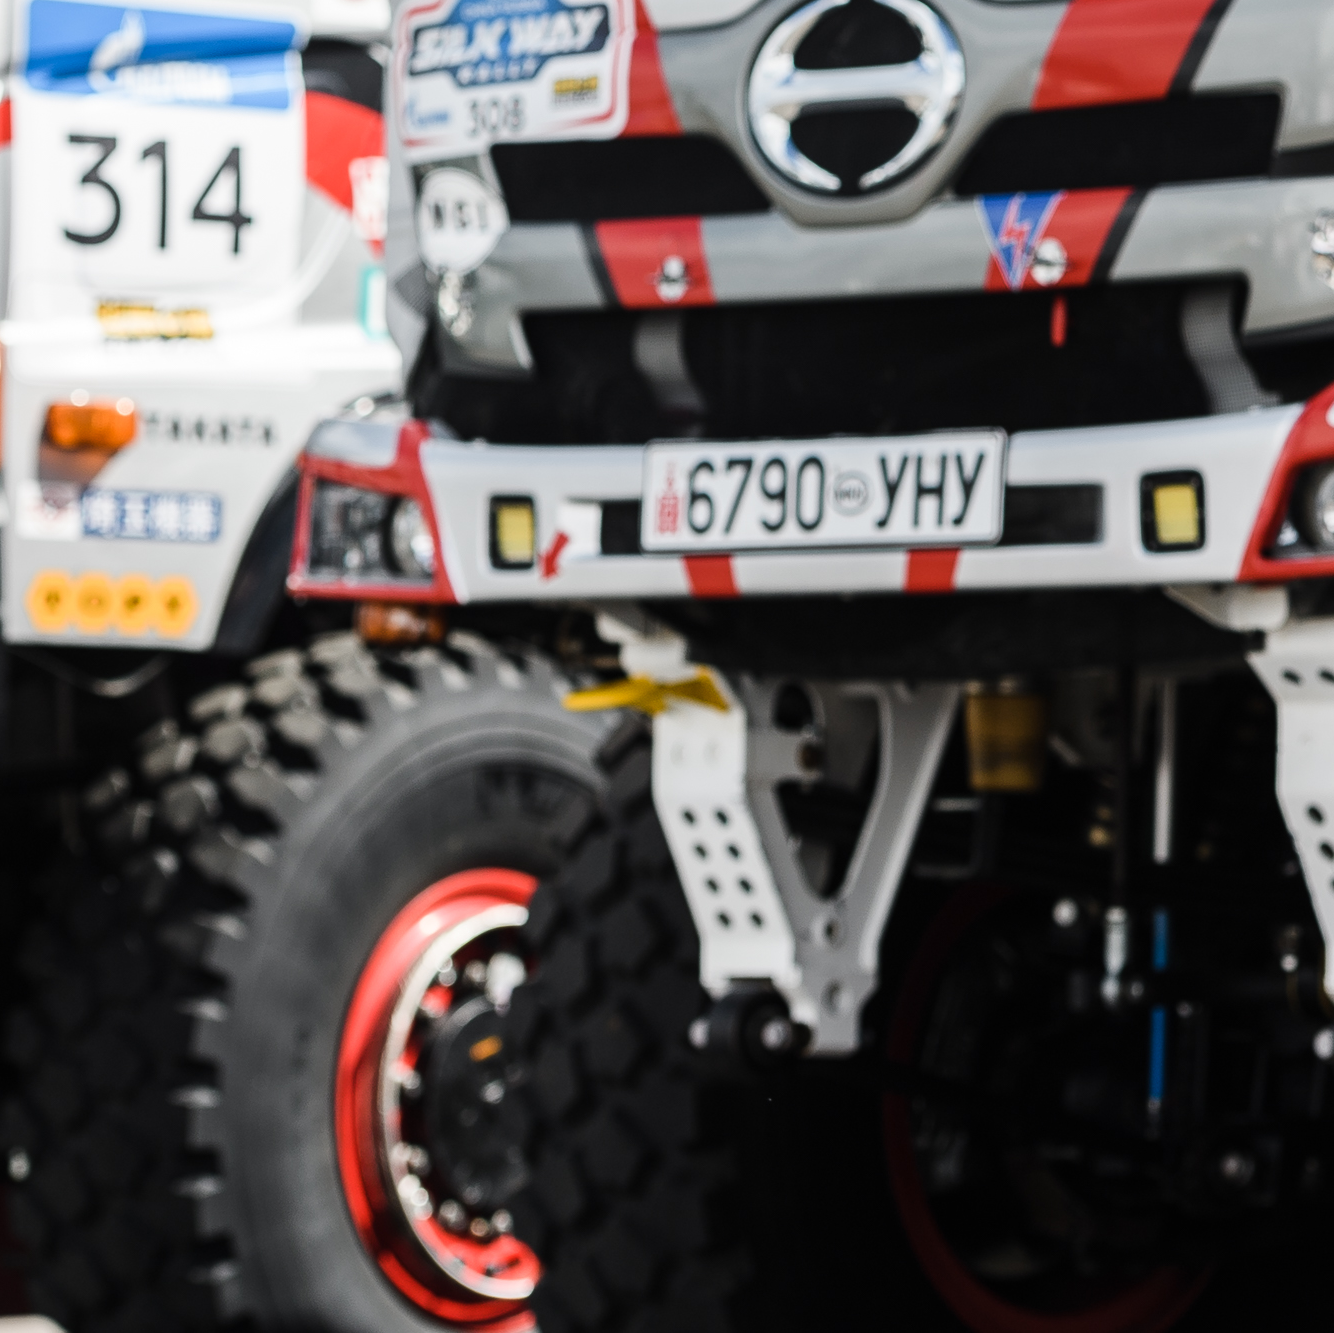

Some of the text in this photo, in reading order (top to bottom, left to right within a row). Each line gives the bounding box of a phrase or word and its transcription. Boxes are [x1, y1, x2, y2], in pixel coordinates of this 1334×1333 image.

[412, 7, 605, 72] SILK WAY
[470, 97, 525, 138] 308
[64, 134, 253, 255] 314
[687, 456, 827, 535] 6790
[875, 453, 986, 529] УНУ
